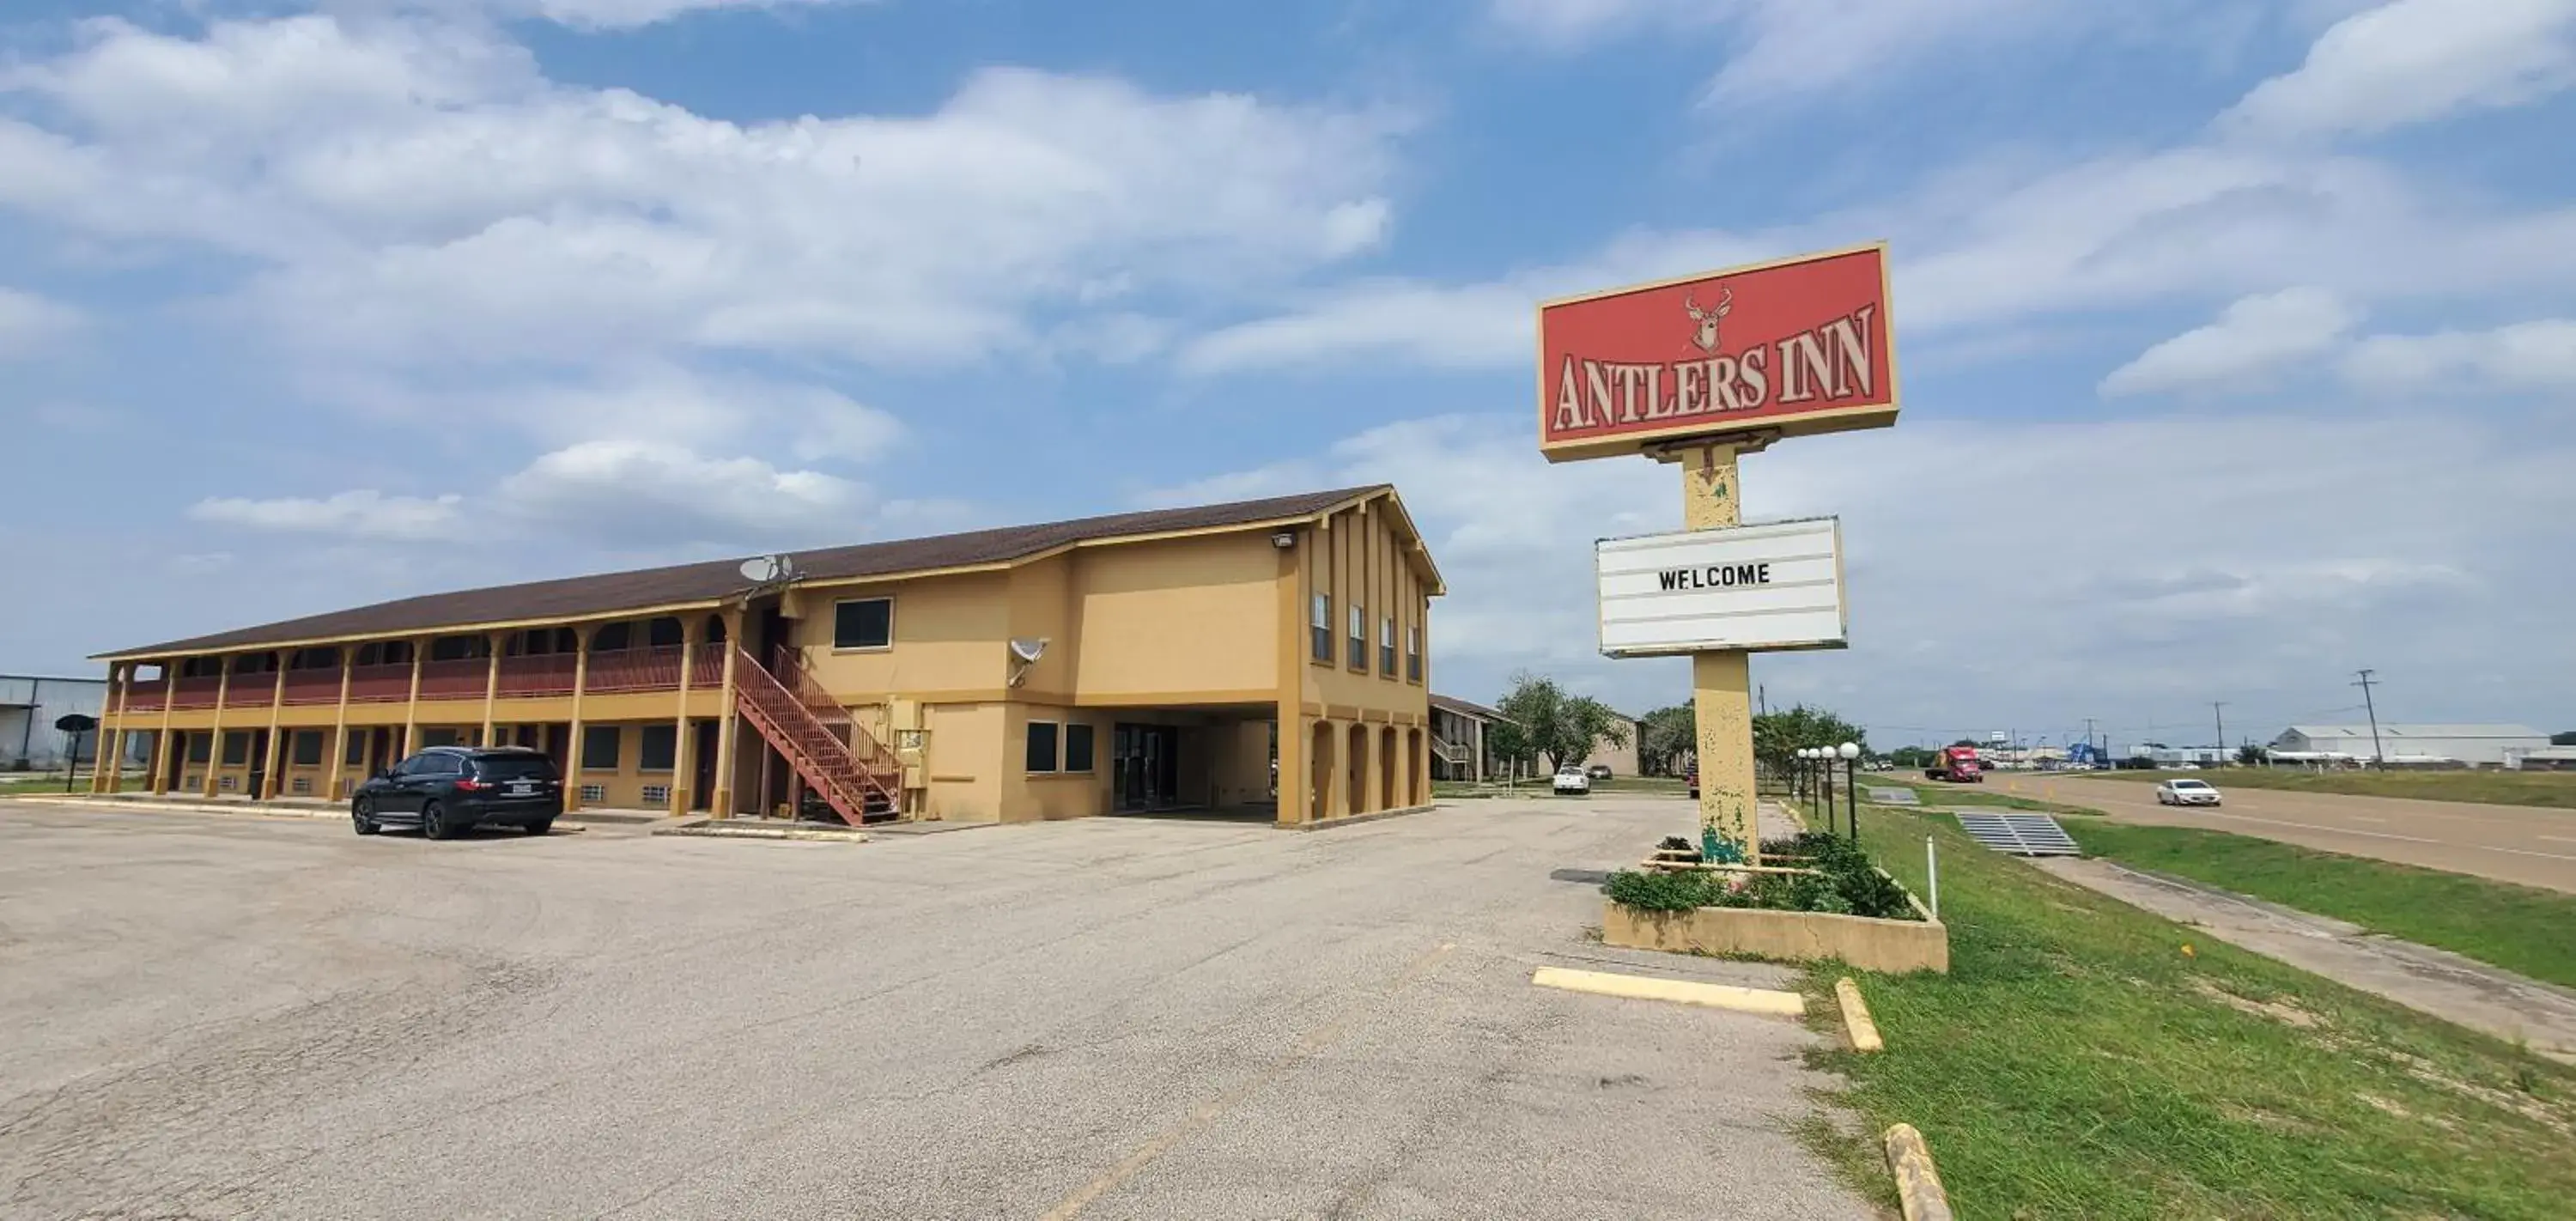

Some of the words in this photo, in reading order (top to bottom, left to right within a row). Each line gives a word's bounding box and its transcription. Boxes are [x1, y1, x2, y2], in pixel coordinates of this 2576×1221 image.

[1552, 344, 1768, 430] ANTLERS
[1778, 303, 1877, 403] INN
[1659, 563, 1771, 590] WELCOME
